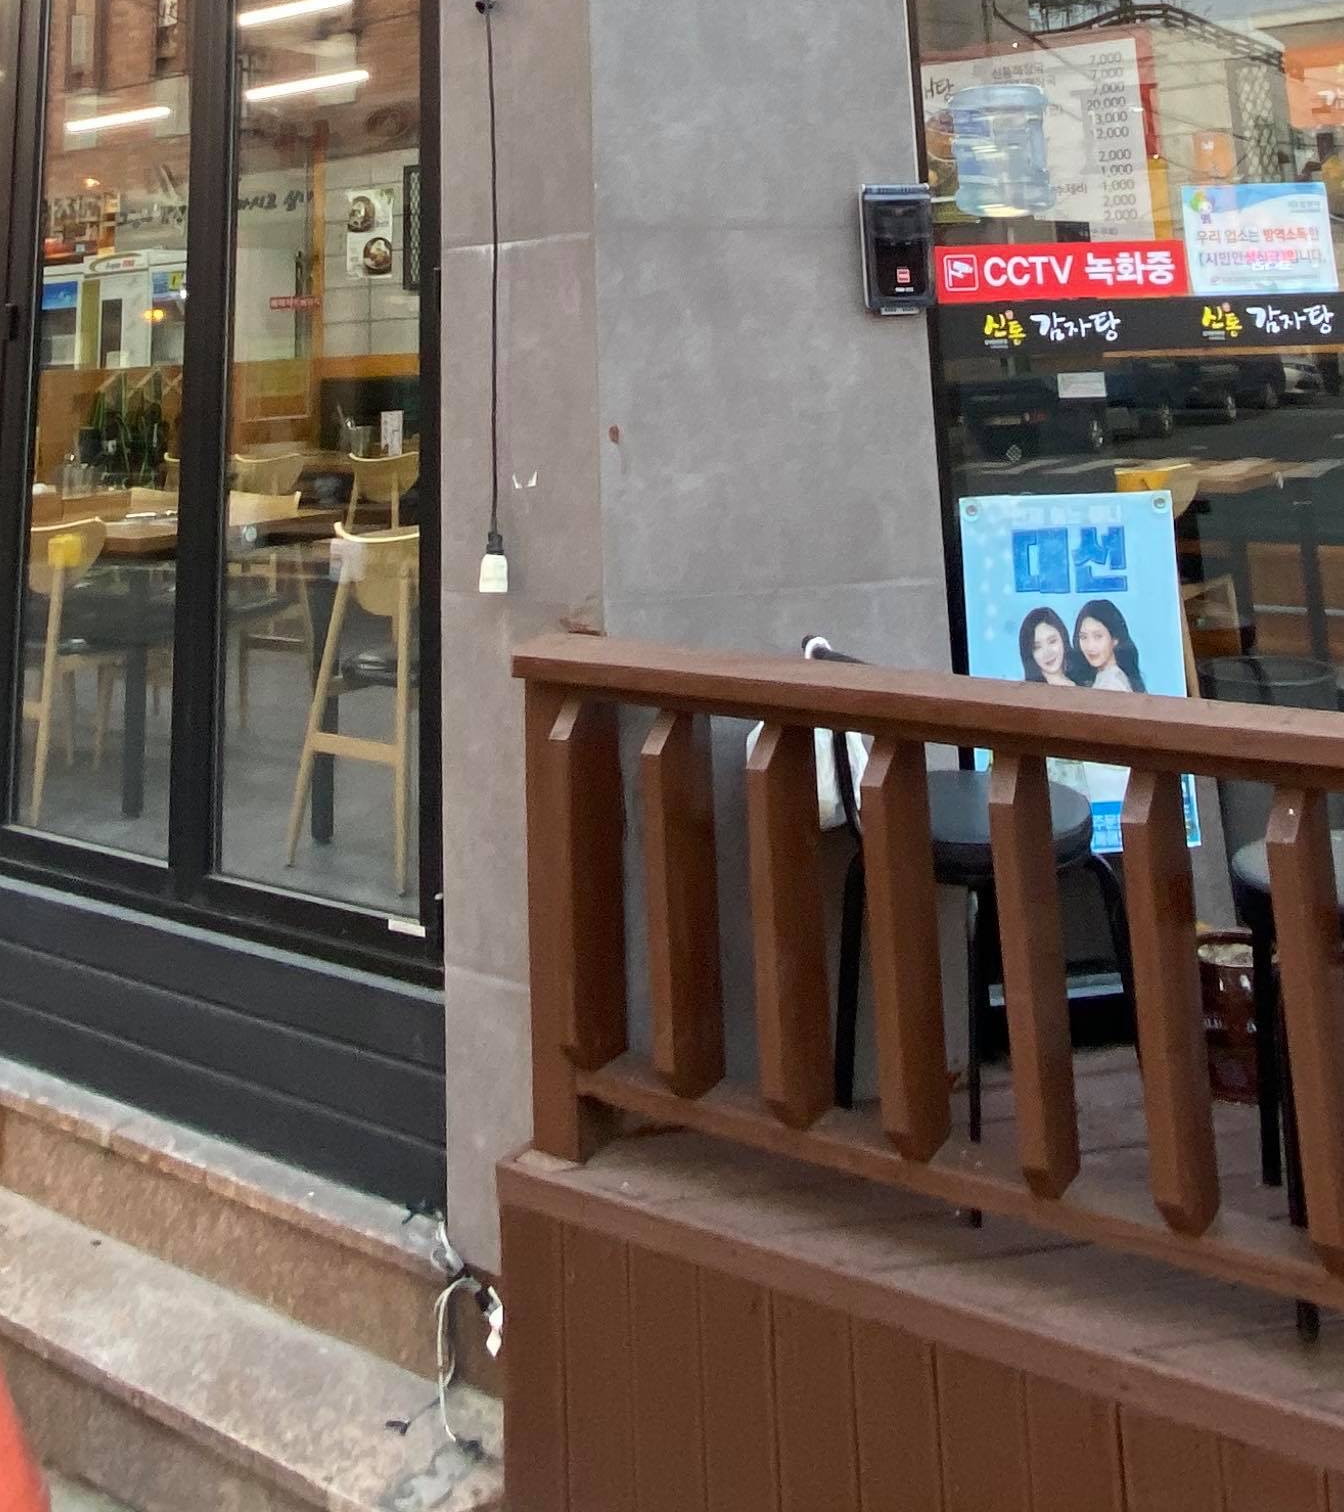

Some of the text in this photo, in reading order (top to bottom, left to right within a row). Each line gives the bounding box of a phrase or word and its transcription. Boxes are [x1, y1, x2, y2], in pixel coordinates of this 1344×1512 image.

[982, 251, 1176, 286] CCTV 녹화중
[1029, 309, 1122, 342] 감자탕
[1245, 303, 1335, 335] 감자탕
[1011, 525, 1129, 595] 대선
